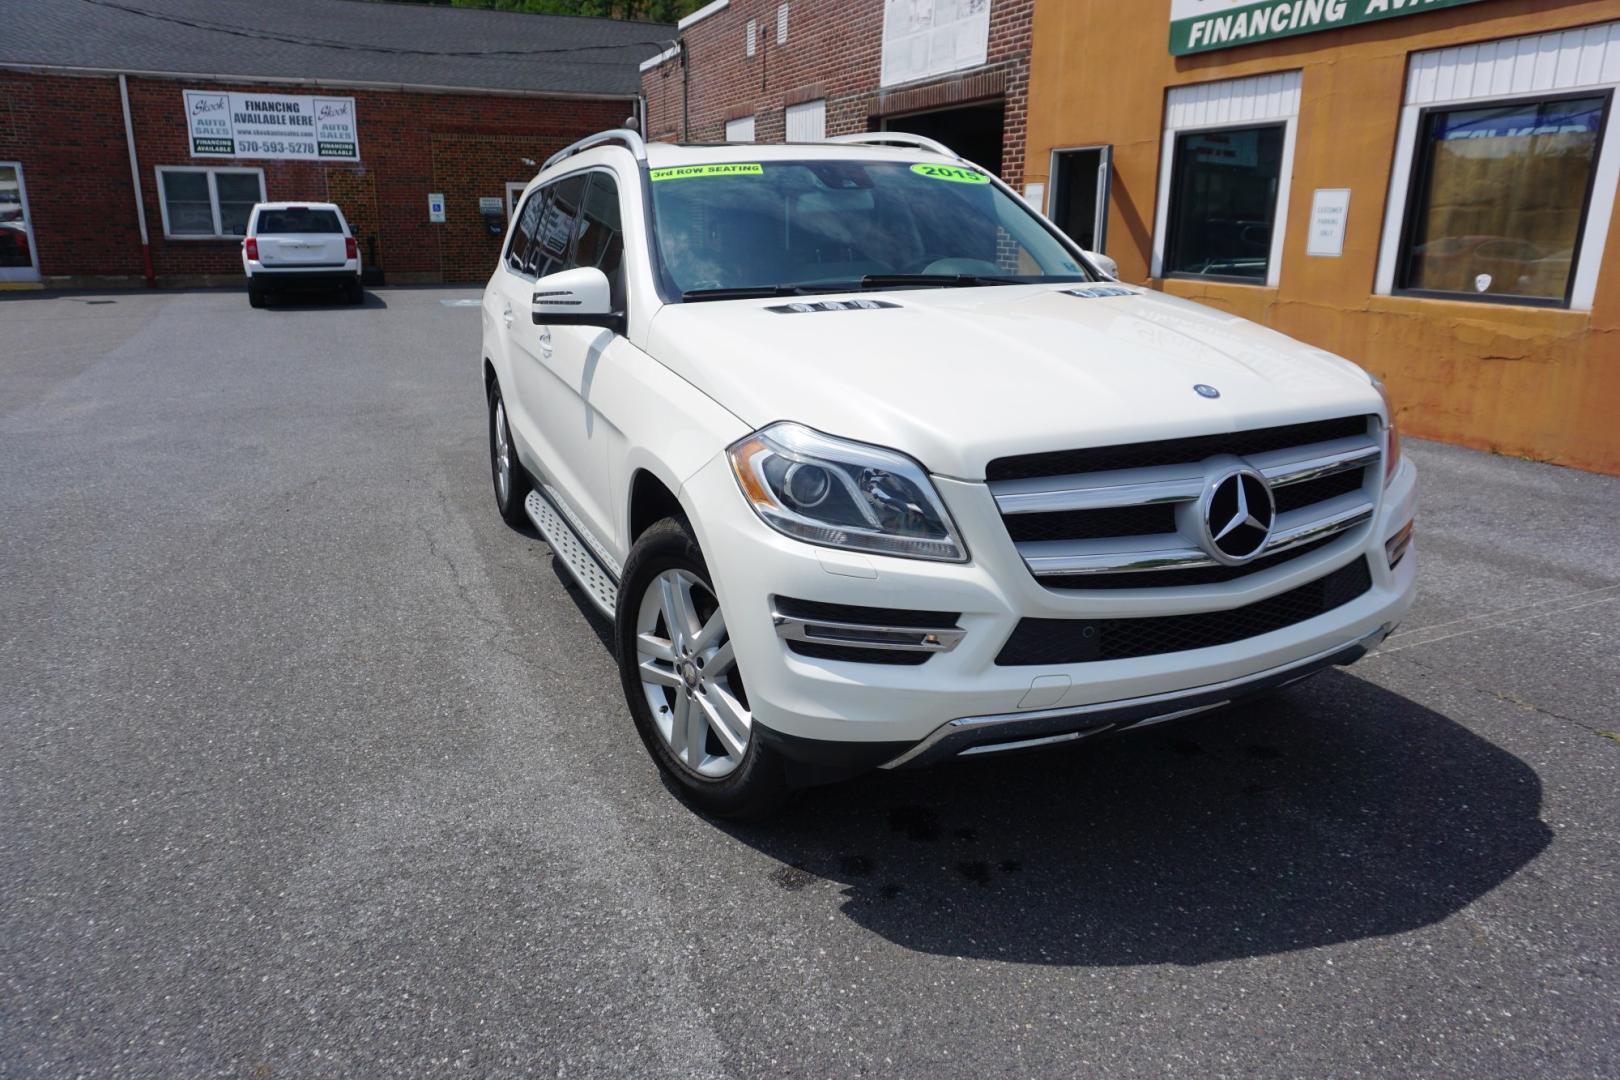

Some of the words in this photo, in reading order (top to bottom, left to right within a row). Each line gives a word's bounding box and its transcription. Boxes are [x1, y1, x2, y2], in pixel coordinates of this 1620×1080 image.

[1187, 0, 1348, 48] FINANCING
[244, 100, 300, 113] FINANCING
[197, 118, 226, 127] AUTO
[234, 112, 287, 126] AVAILABLE
[288, 115, 314, 126] HERE
[194, 127, 230, 135] SALES
[321, 123, 349, 132] AUTO
[320, 131, 352, 140] SALES
[195, 139, 232, 147] FINANCING
[238, 140, 315, 154] 570-593-5278
[653, 170, 673, 178] 3rd
[676, 166, 705, 176] ROW
[707, 164, 760, 173] SEATING
[921, 166, 982, 181] 2015
